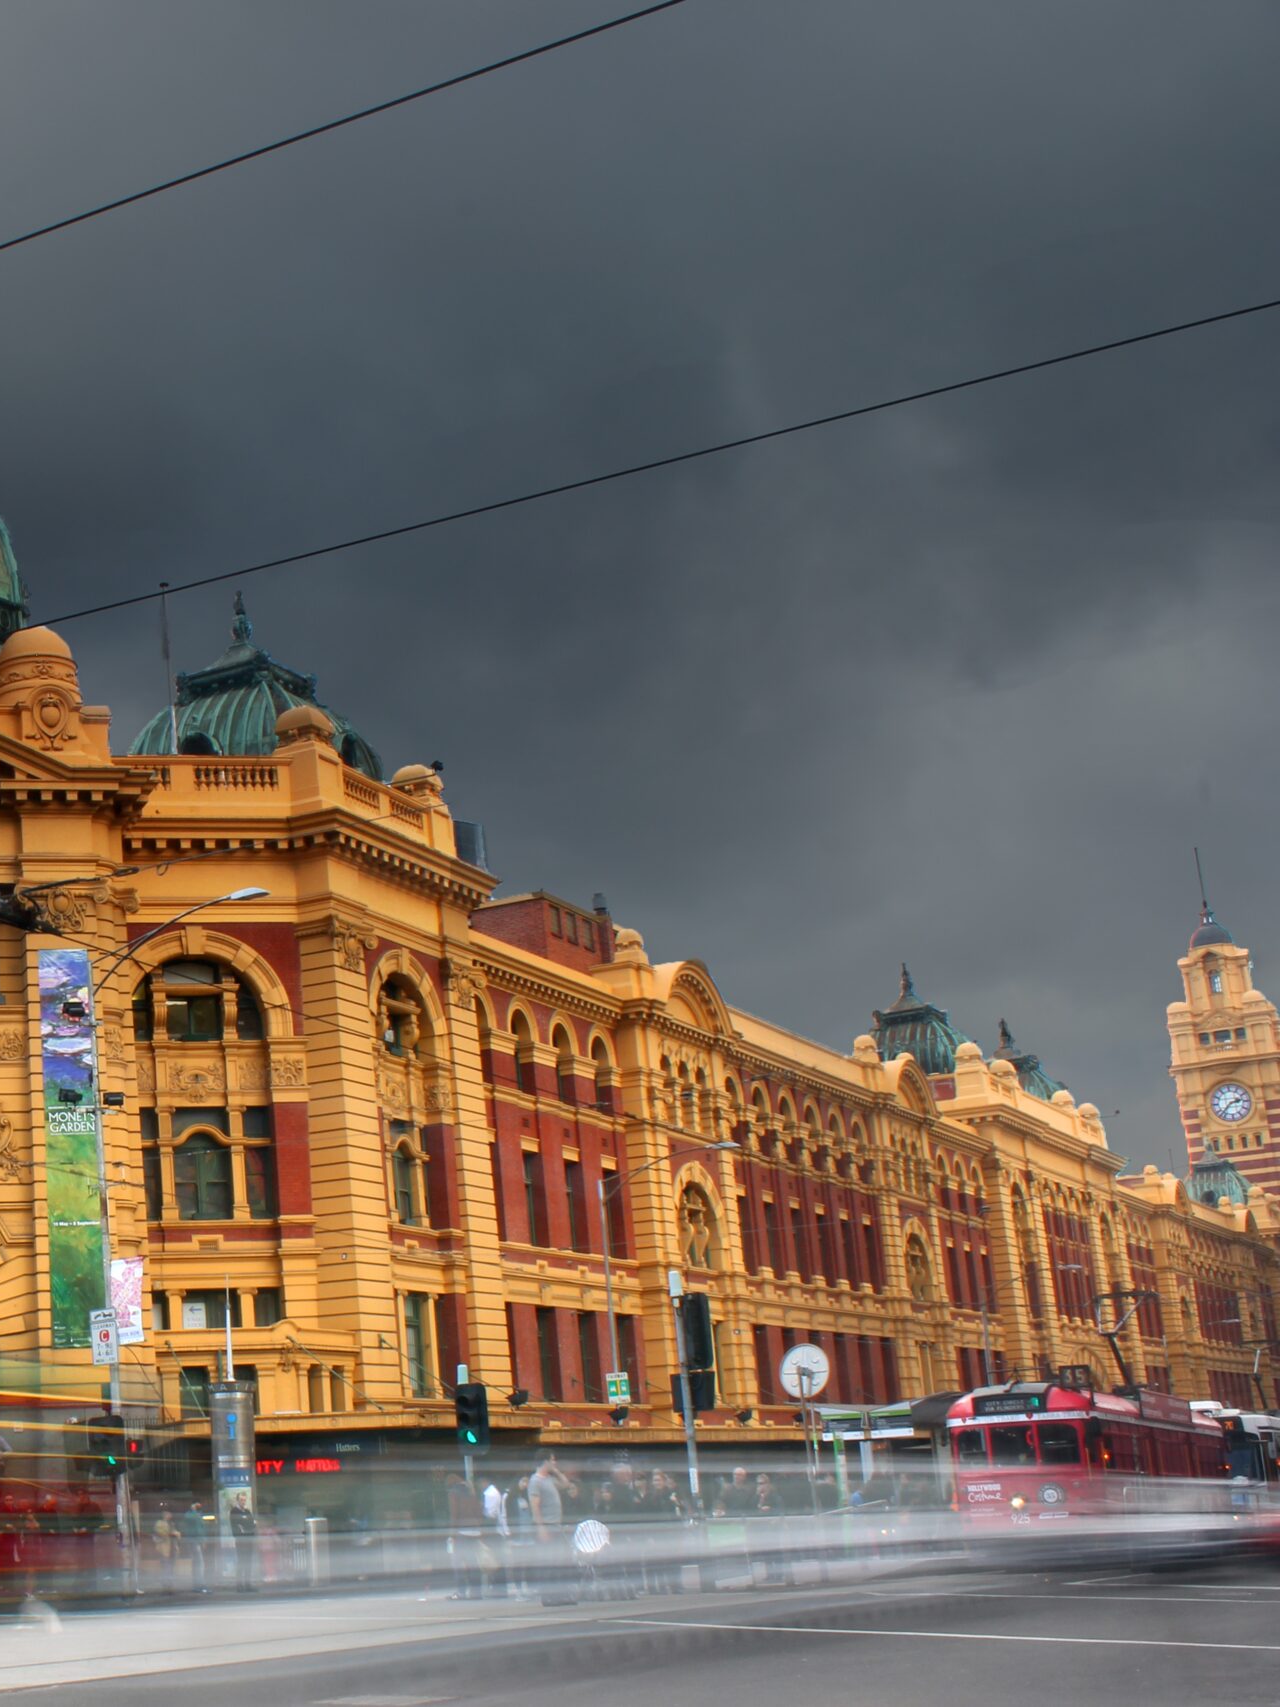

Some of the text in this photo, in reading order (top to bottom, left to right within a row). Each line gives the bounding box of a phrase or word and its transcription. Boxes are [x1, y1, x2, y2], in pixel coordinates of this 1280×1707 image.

[49, 1122, 96, 1133] GARDEN
[101, 1331, 108, 1341] C
[336, 1443, 360, 1453] Hatters
[967, 1484, 1001, 1492] HOLLYWOOD
[1011, 1512, 1031, 1525] 925
